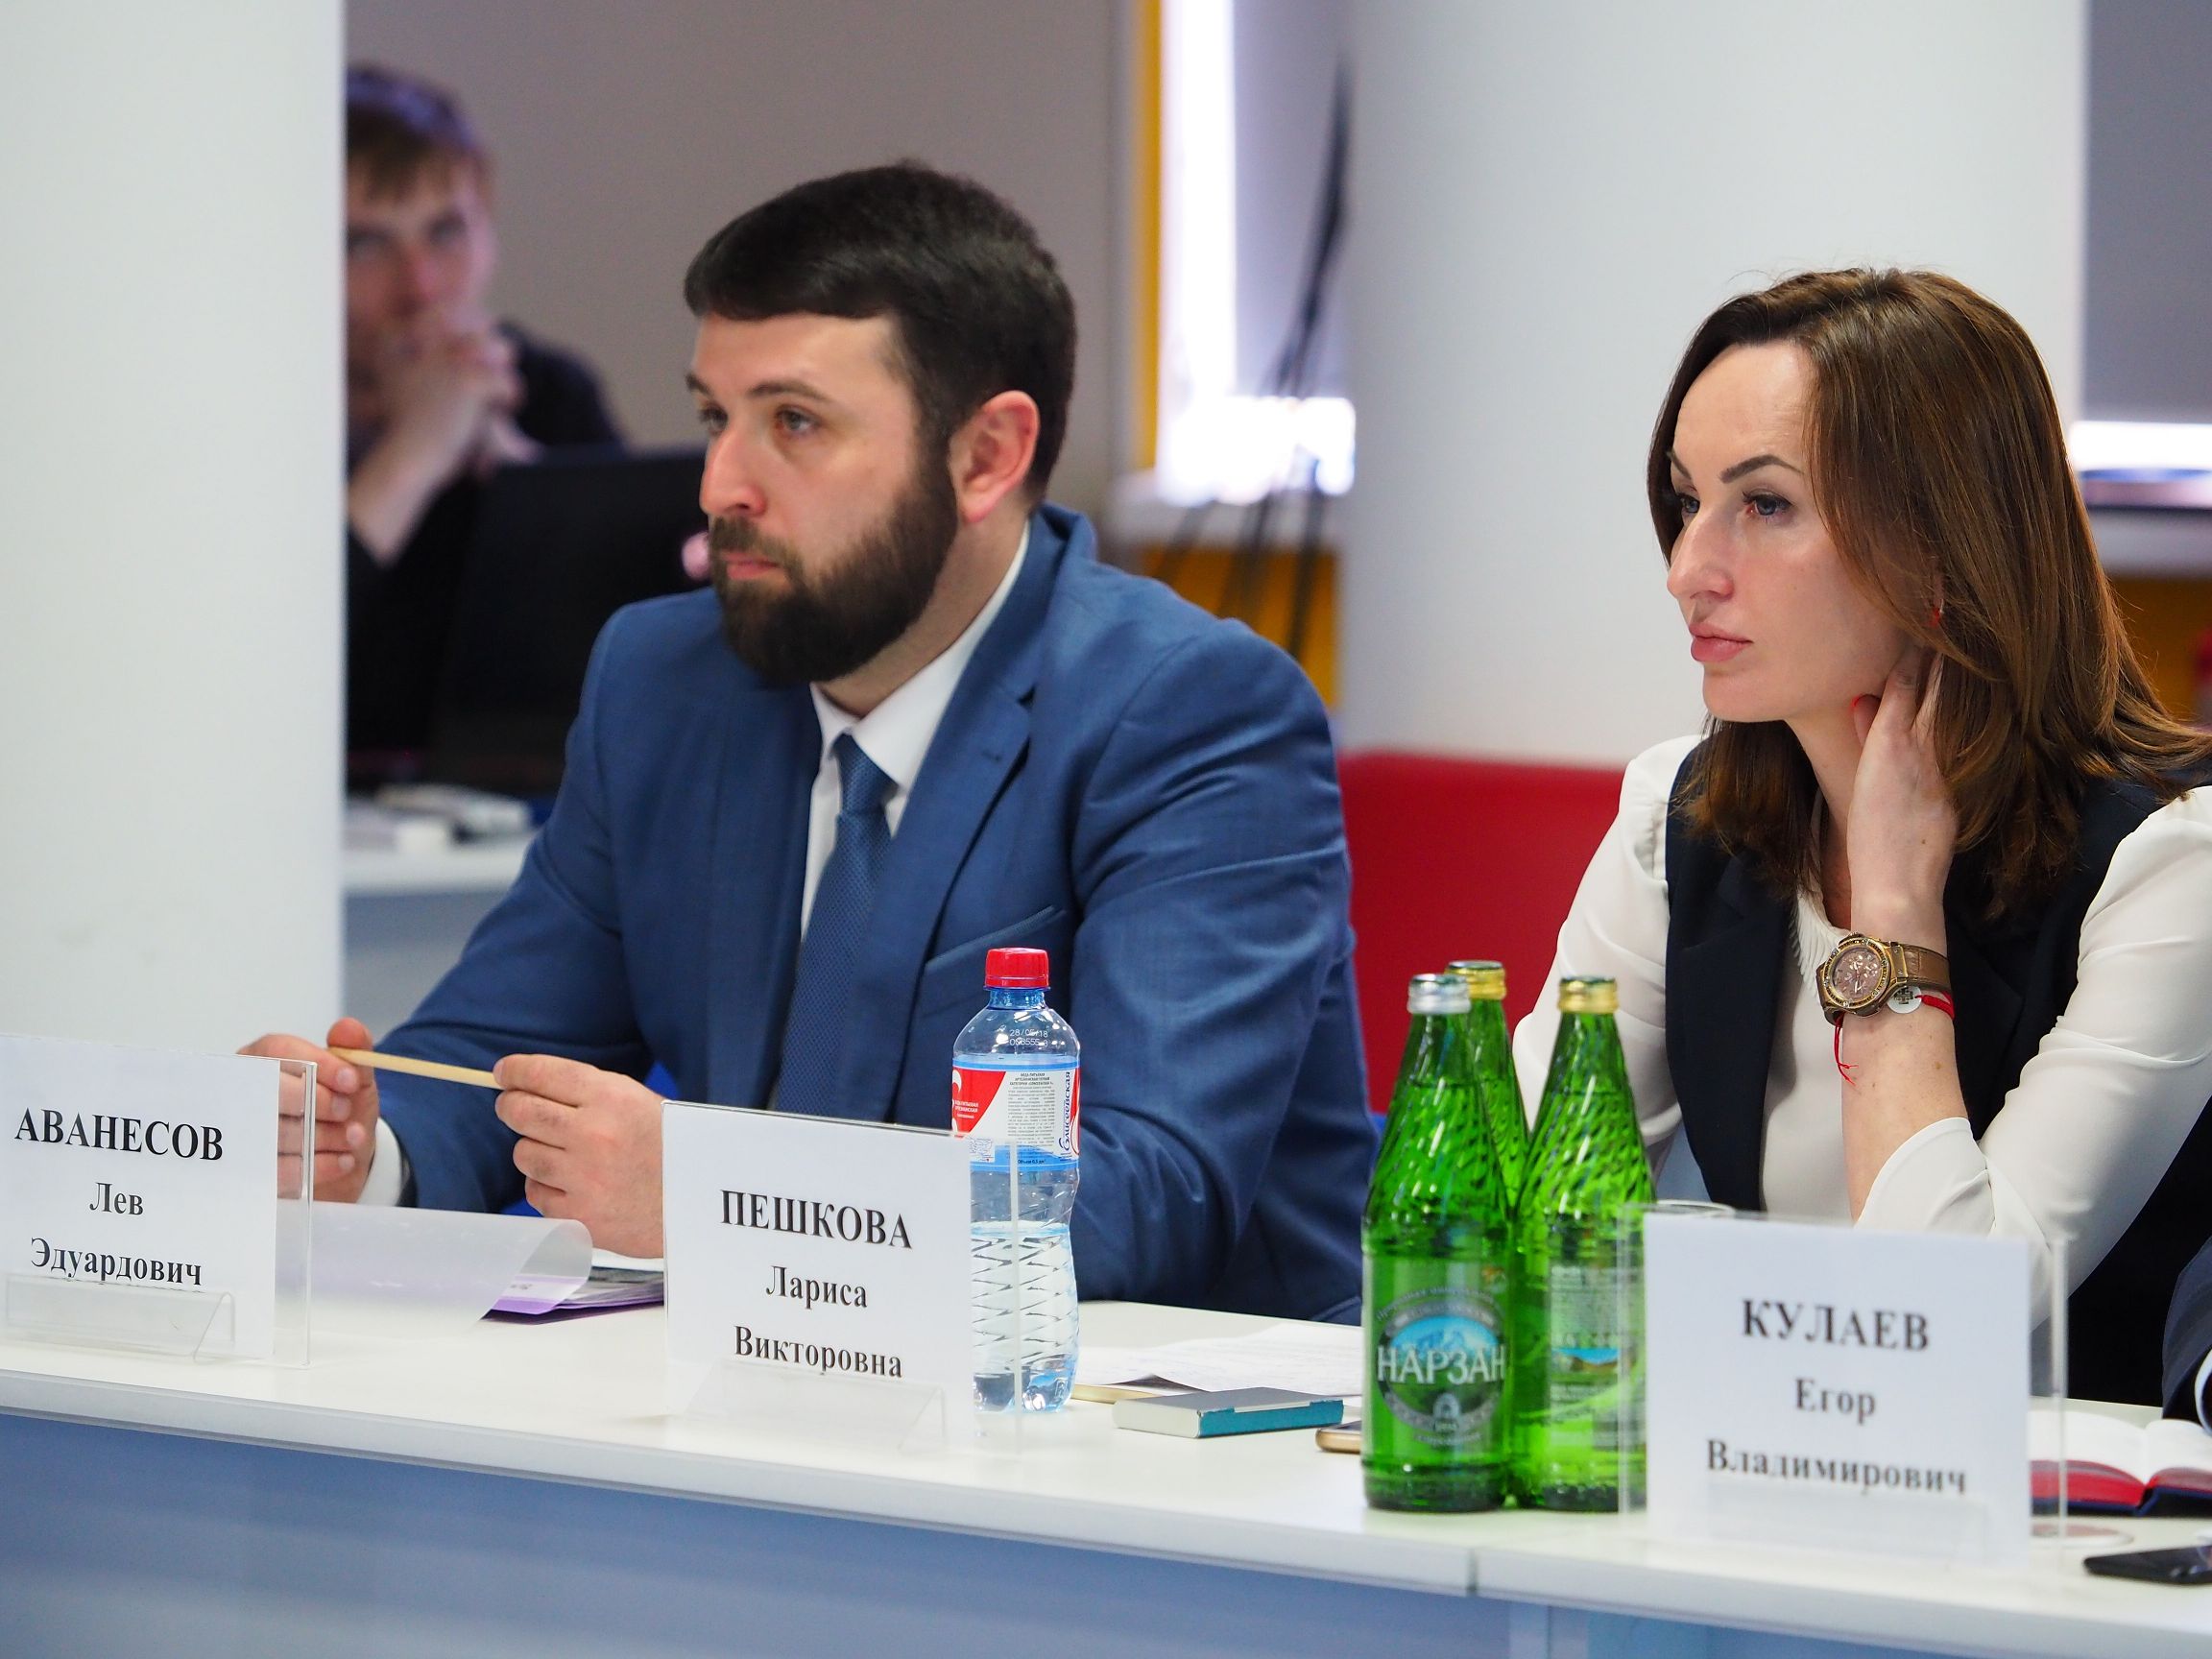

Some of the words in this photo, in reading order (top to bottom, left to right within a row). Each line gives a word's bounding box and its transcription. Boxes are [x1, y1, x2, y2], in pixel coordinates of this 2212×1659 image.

[14, 1108, 223, 1161] АВАНЕСОВ
[89, 1182, 144, 1215] Лев
[721, 1190, 913, 1249] ПЕШКОВА
[31, 1238, 202, 1286] Эдуардович
[765, 1265, 868, 1310] Лариса
[1743, 1299, 1930, 1352] КУЛАЕВ
[734, 1325, 902, 1379] Викторовна
[1377, 1345, 1506, 1385] НАРЗАН
[1794, 1378, 1876, 1426] Егор
[1706, 1439, 1967, 1495] Владимирович
